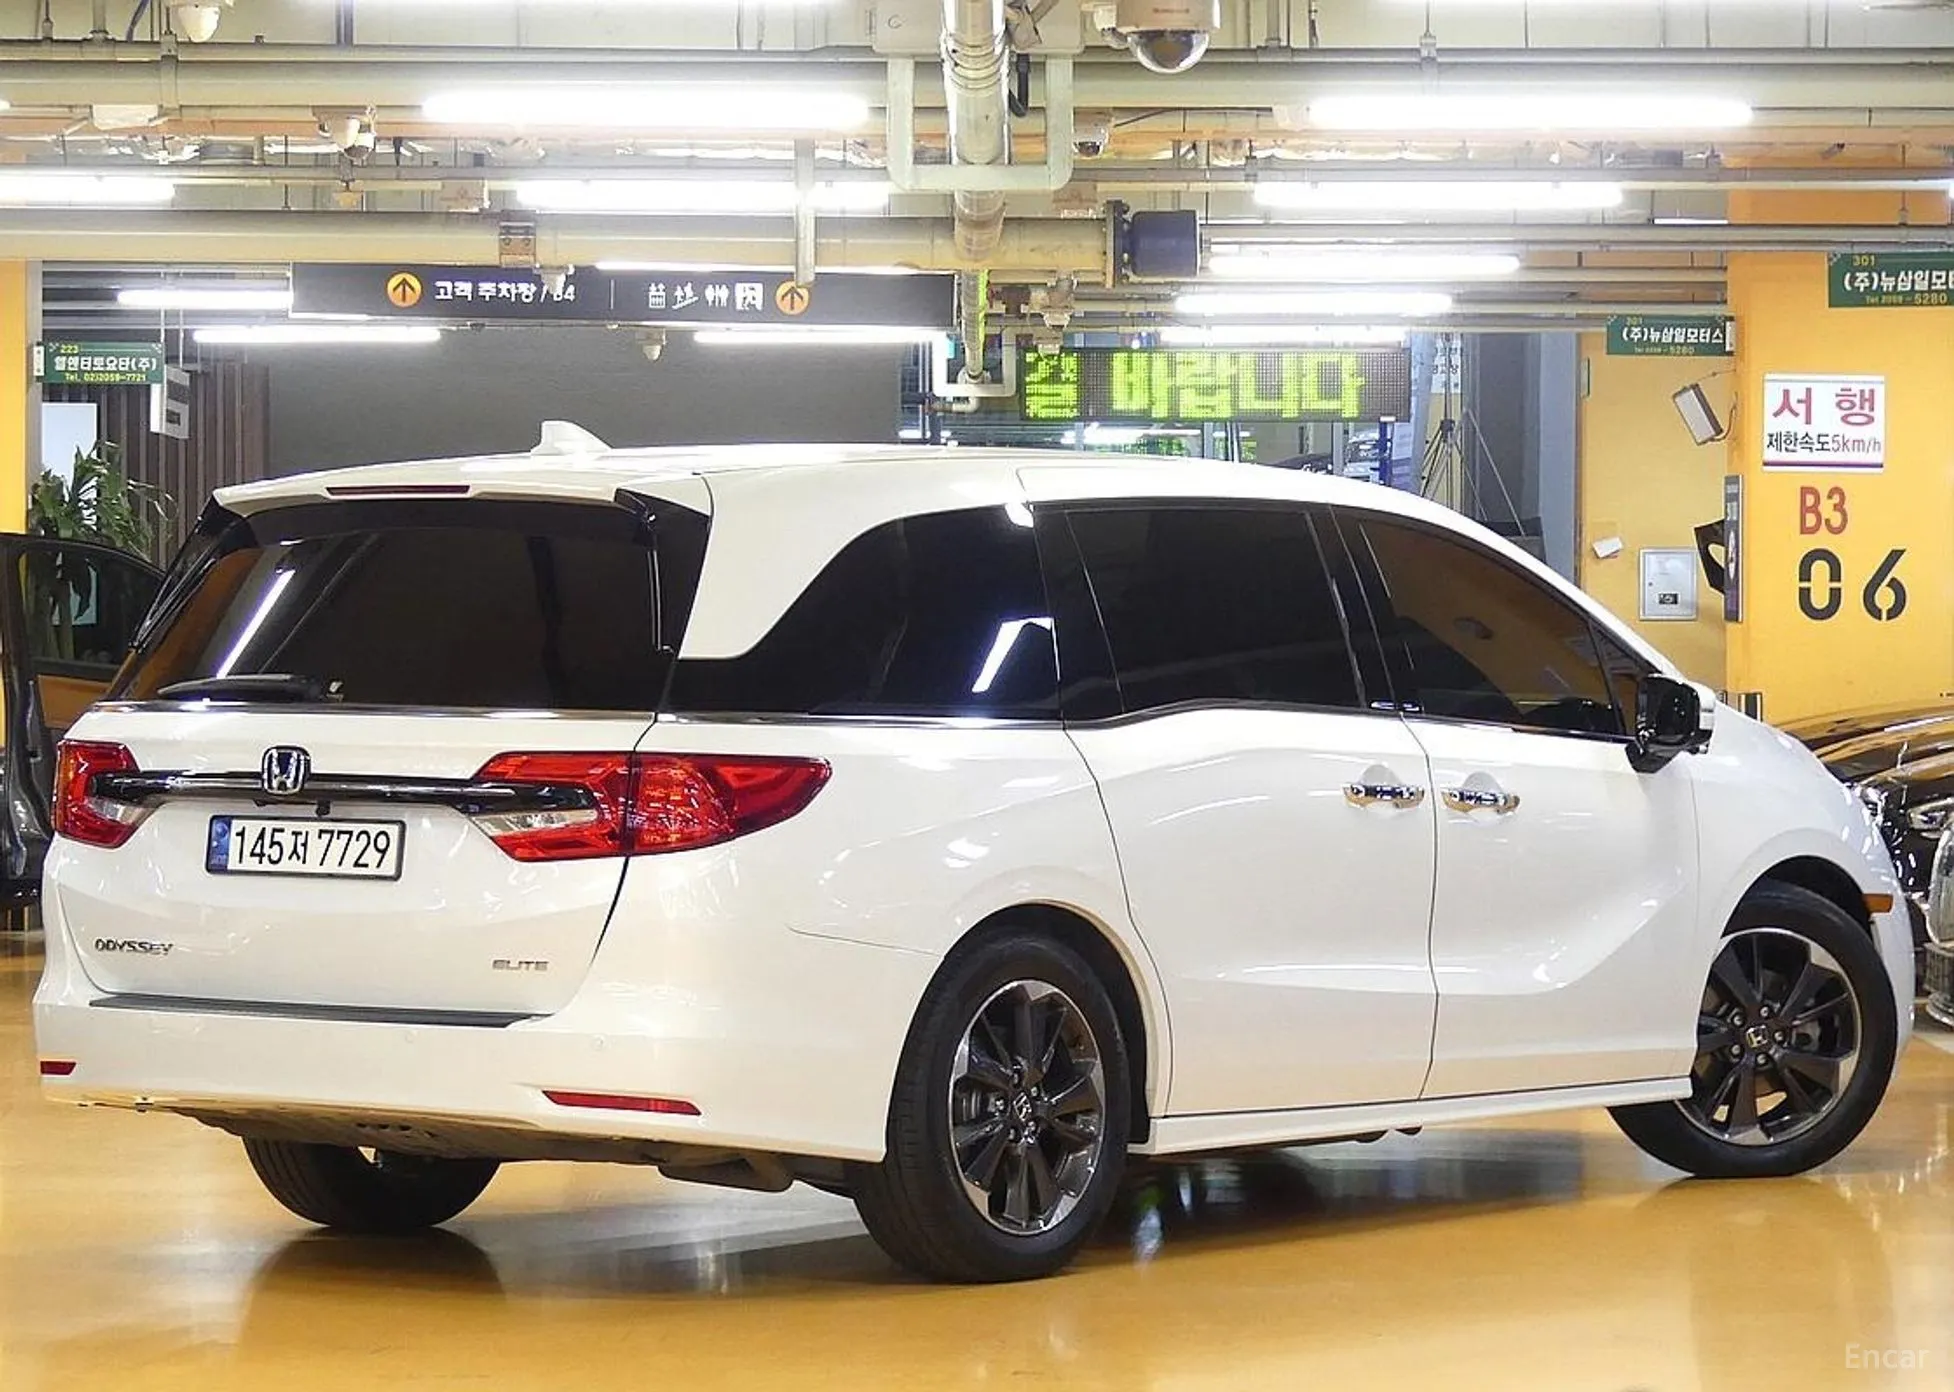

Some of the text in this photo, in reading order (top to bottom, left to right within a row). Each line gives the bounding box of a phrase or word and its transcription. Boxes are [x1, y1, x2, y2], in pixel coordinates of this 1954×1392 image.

[1852, 254, 1876, 267] 301
[434, 280, 473, 301] 고객
[478, 281, 537, 303] 주차장
[1622, 326, 1724, 344] (주)뉴삼일모터스
[1112, 351, 1366, 418] 바랍니다
[1799, 486, 1848, 536] B3
[316, 827, 391, 869] 7729
[94, 938, 174, 956] ODYSSEY
[492, 959, 549, 971] ELITE
